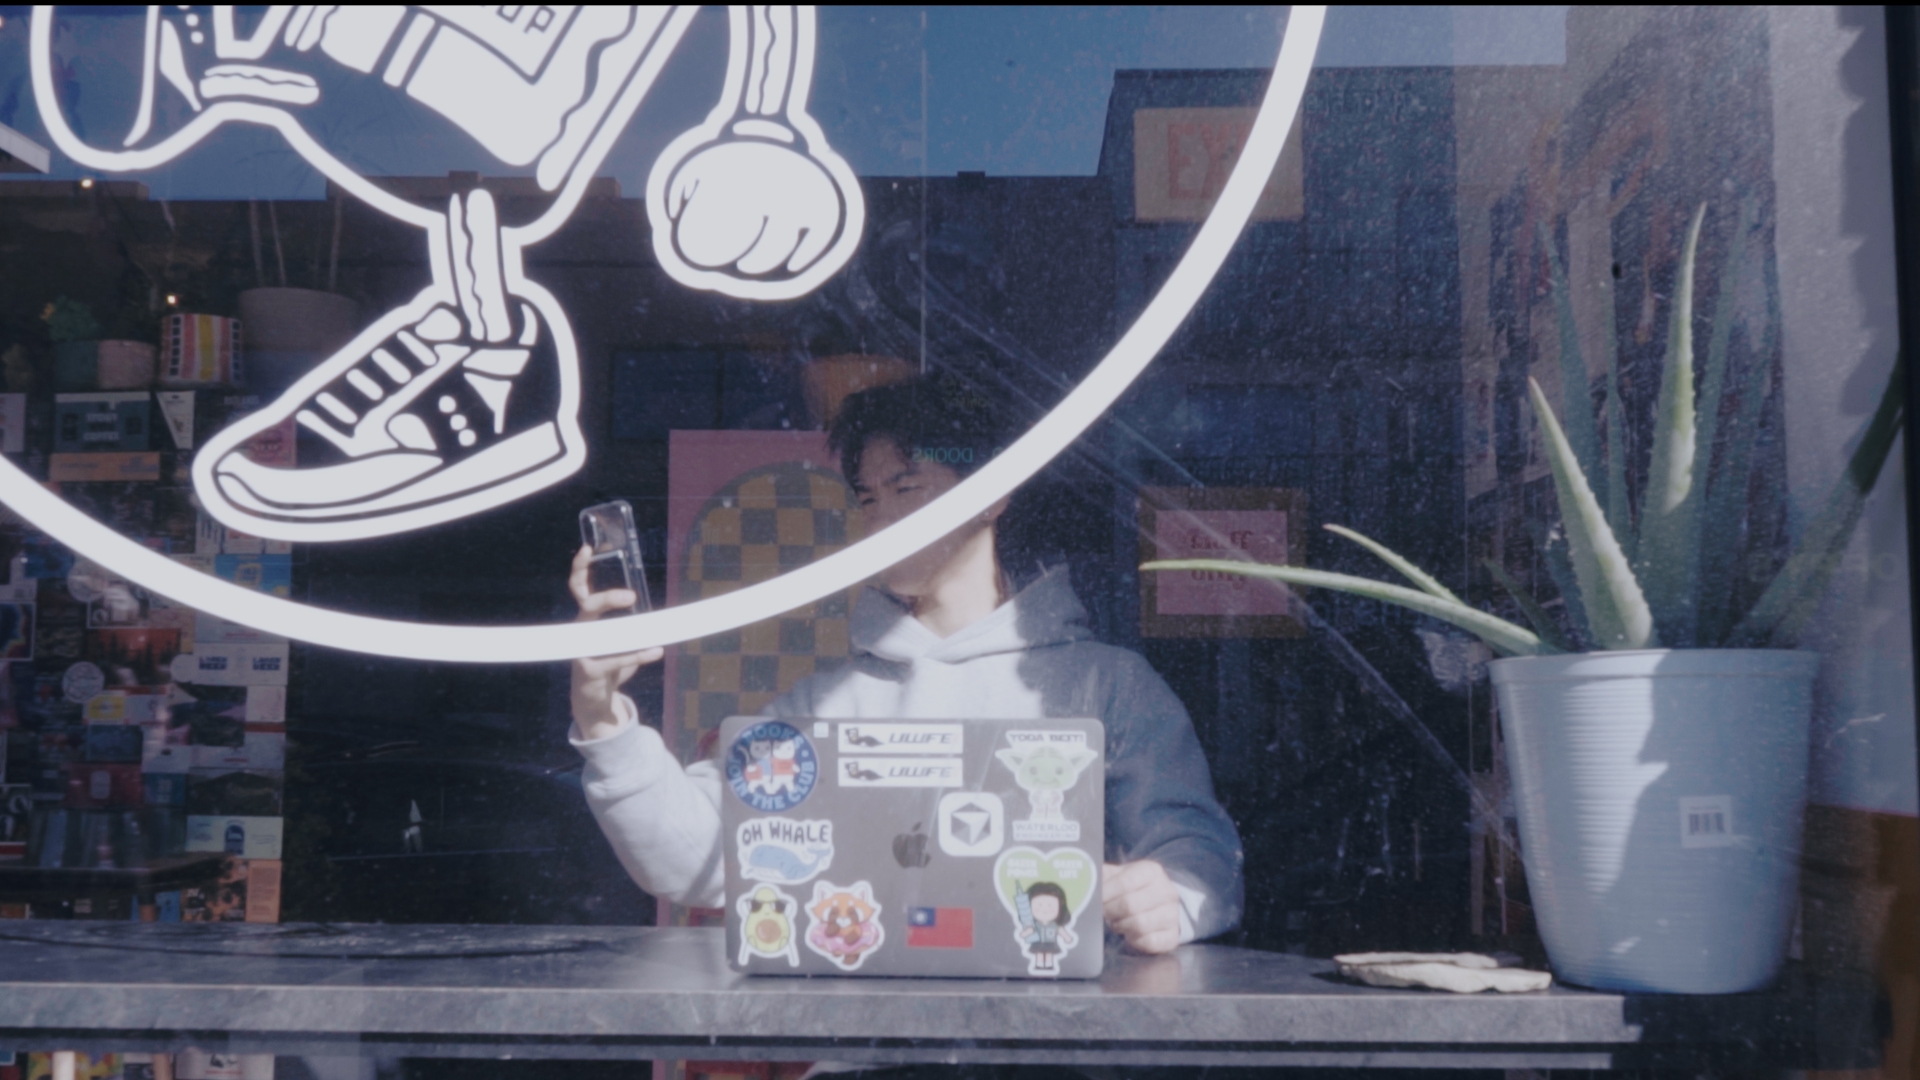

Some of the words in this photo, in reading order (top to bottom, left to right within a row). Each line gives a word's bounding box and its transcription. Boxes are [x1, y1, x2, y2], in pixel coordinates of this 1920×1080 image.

[1167, 123, 1273, 199] EX
[728, 755, 749, 798] JOIN
[787, 761, 815, 802] CLUB
[751, 793, 786, 810] THE
[742, 823, 763, 846] OH
[769, 821, 830, 845] WHALE
[1015, 823, 1078, 832] WATERLOO
